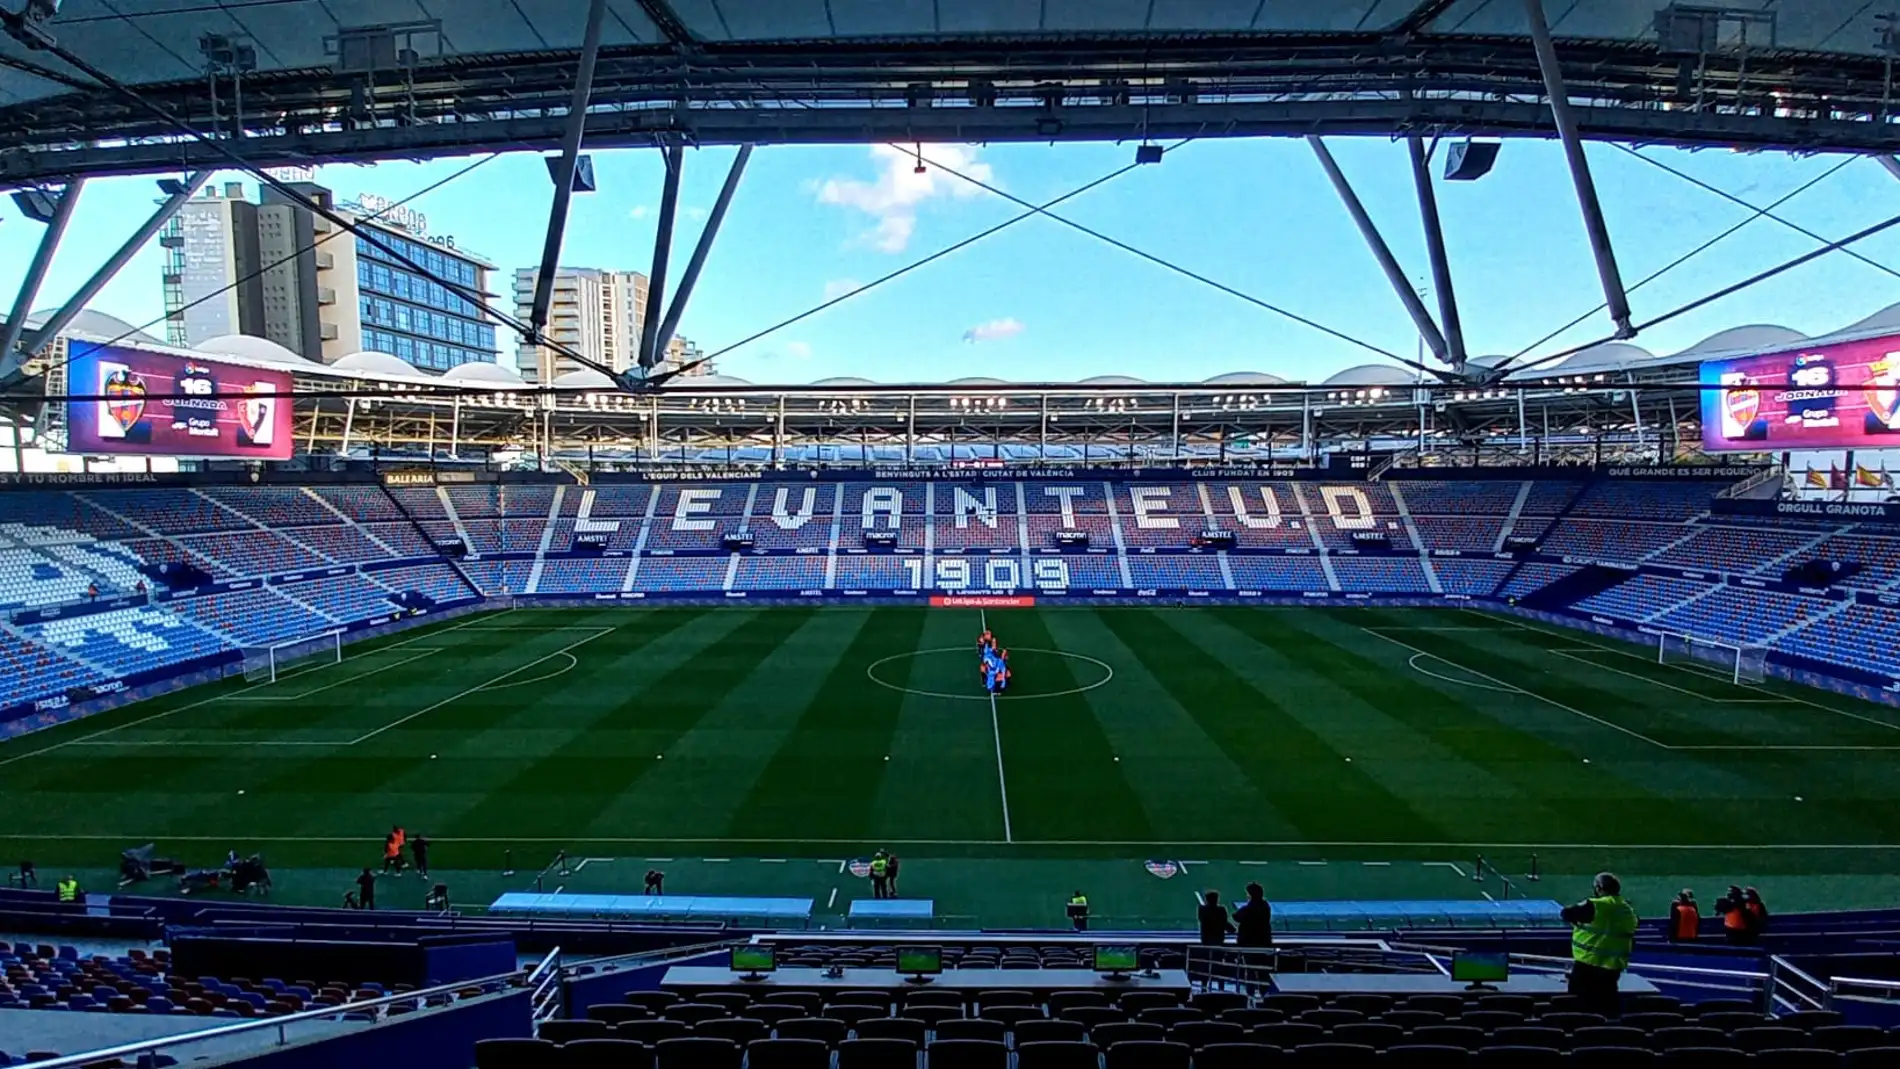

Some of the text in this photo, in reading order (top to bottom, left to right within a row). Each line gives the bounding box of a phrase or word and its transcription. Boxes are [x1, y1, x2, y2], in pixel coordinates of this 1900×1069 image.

[1792, 367, 1829, 386] 16
[180, 377, 212, 394] 16
[189, 417, 210, 428] Grupo
[680, 472, 704, 480] DELS
[705, 471, 762, 479] VALENCIANS
[875, 470, 931, 478] BENVINGUTS
[933, 470, 941, 478] A
[983, 470, 1013, 478] CIUTAT
[1218, 469, 1255, 477] FUNDAT
[1273, 469, 1295, 477] 1909
[1632, 468, 1676, 477] GRANDE
[1677, 468, 1690, 476] ES
[1691, 468, 1712, 476] SER
[574, 487, 1180, 532] LEVANTE
[1777, 503, 1885, 516] ORGULL GRANOTA
[866, 531, 897, 539] macron
[1055, 531, 1087, 539] macron
[1201, 531, 1232, 539] AMSTEL
[904, 558, 1070, 589] 1909
